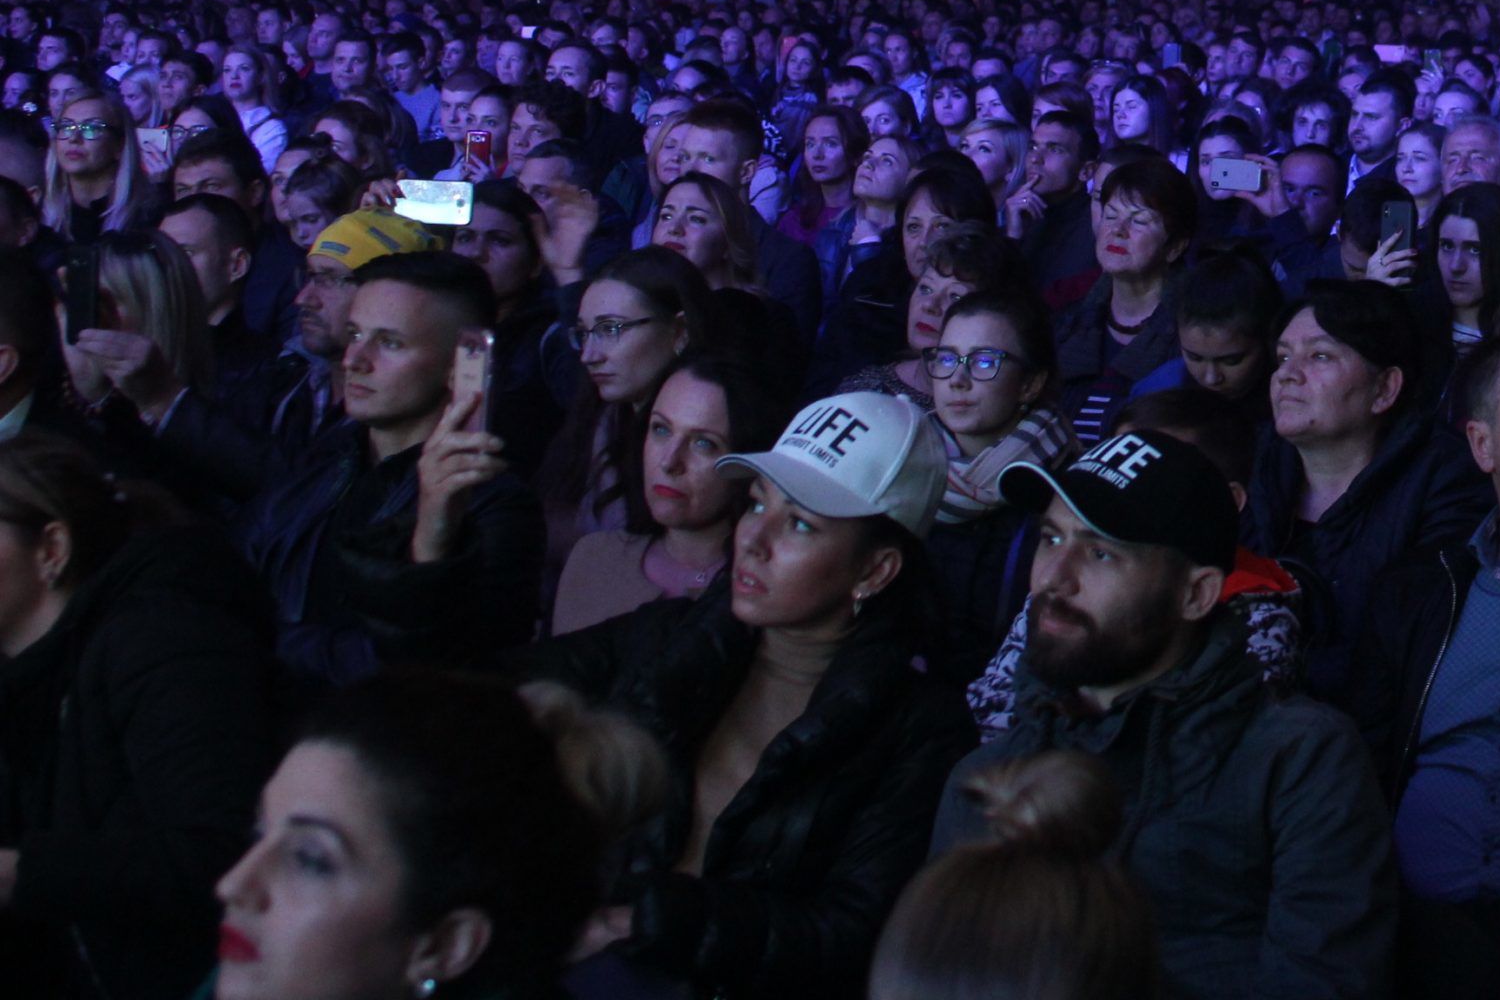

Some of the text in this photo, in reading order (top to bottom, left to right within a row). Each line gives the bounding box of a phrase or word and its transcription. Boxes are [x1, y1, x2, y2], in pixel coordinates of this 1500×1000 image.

[793, 406, 869, 457] LIFE
[809, 444, 839, 468] LIMITS
[1078, 433, 1163, 480] LIFE
